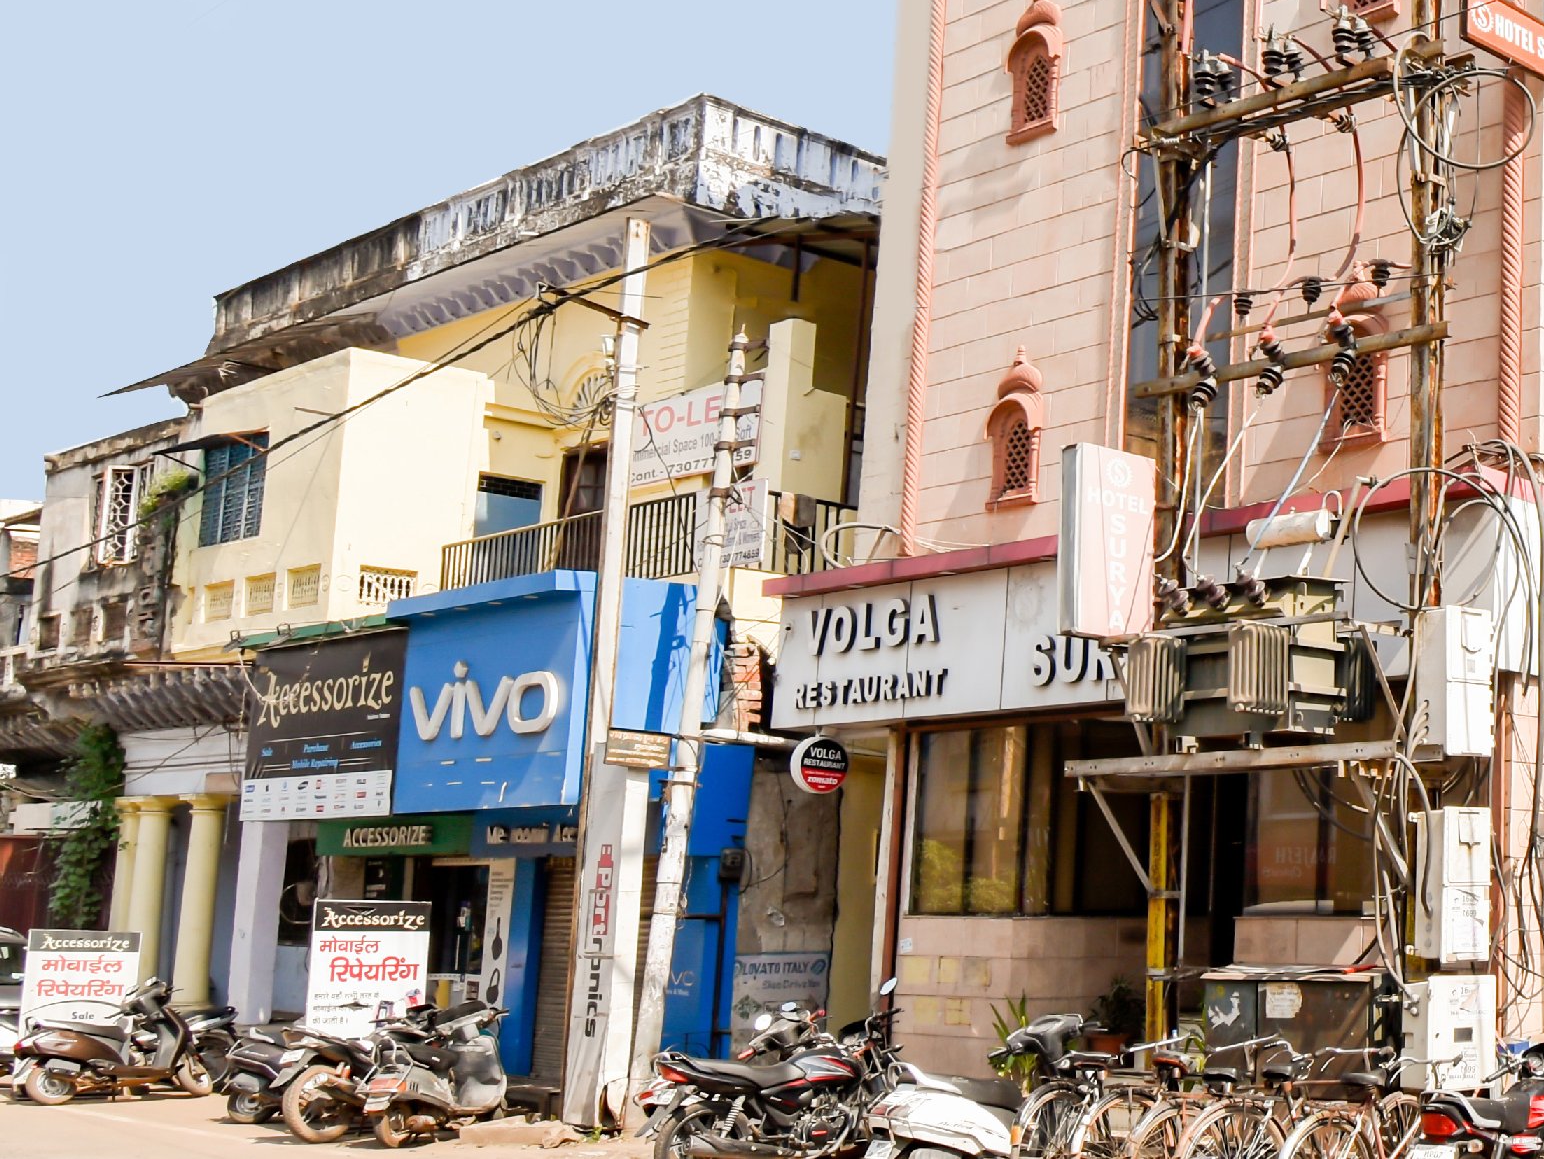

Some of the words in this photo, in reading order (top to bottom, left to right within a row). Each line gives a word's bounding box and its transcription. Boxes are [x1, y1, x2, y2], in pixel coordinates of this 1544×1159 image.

[1495, 13, 1534, 55] HOTEL
[673, 438, 698, 454] Space
[1088, 487, 1149, 515] HOTEL
[1108, 514, 1127, 631] SURYA
[806, 594, 940, 656] VOLGA
[257, 650, 393, 728] Accessorize
[410, 660, 559, 740] vivo
[794, 668, 948, 709] RESTAURANT
[804, 758, 845, 770] RESTAURANT
[810, 746, 841, 760] VOLGA
[343, 826, 430, 847] ACCESSORIZE
[320, 906, 425, 930] Accessorize
[40, 933, 130, 952] Accessorize
[329, 956, 420, 982] रिपेयरिंग
[782, 962, 809, 974] ITALY
[37, 979, 124, 997] रिपेयरिंग
[71, 1011, 95, 1020] Sale
